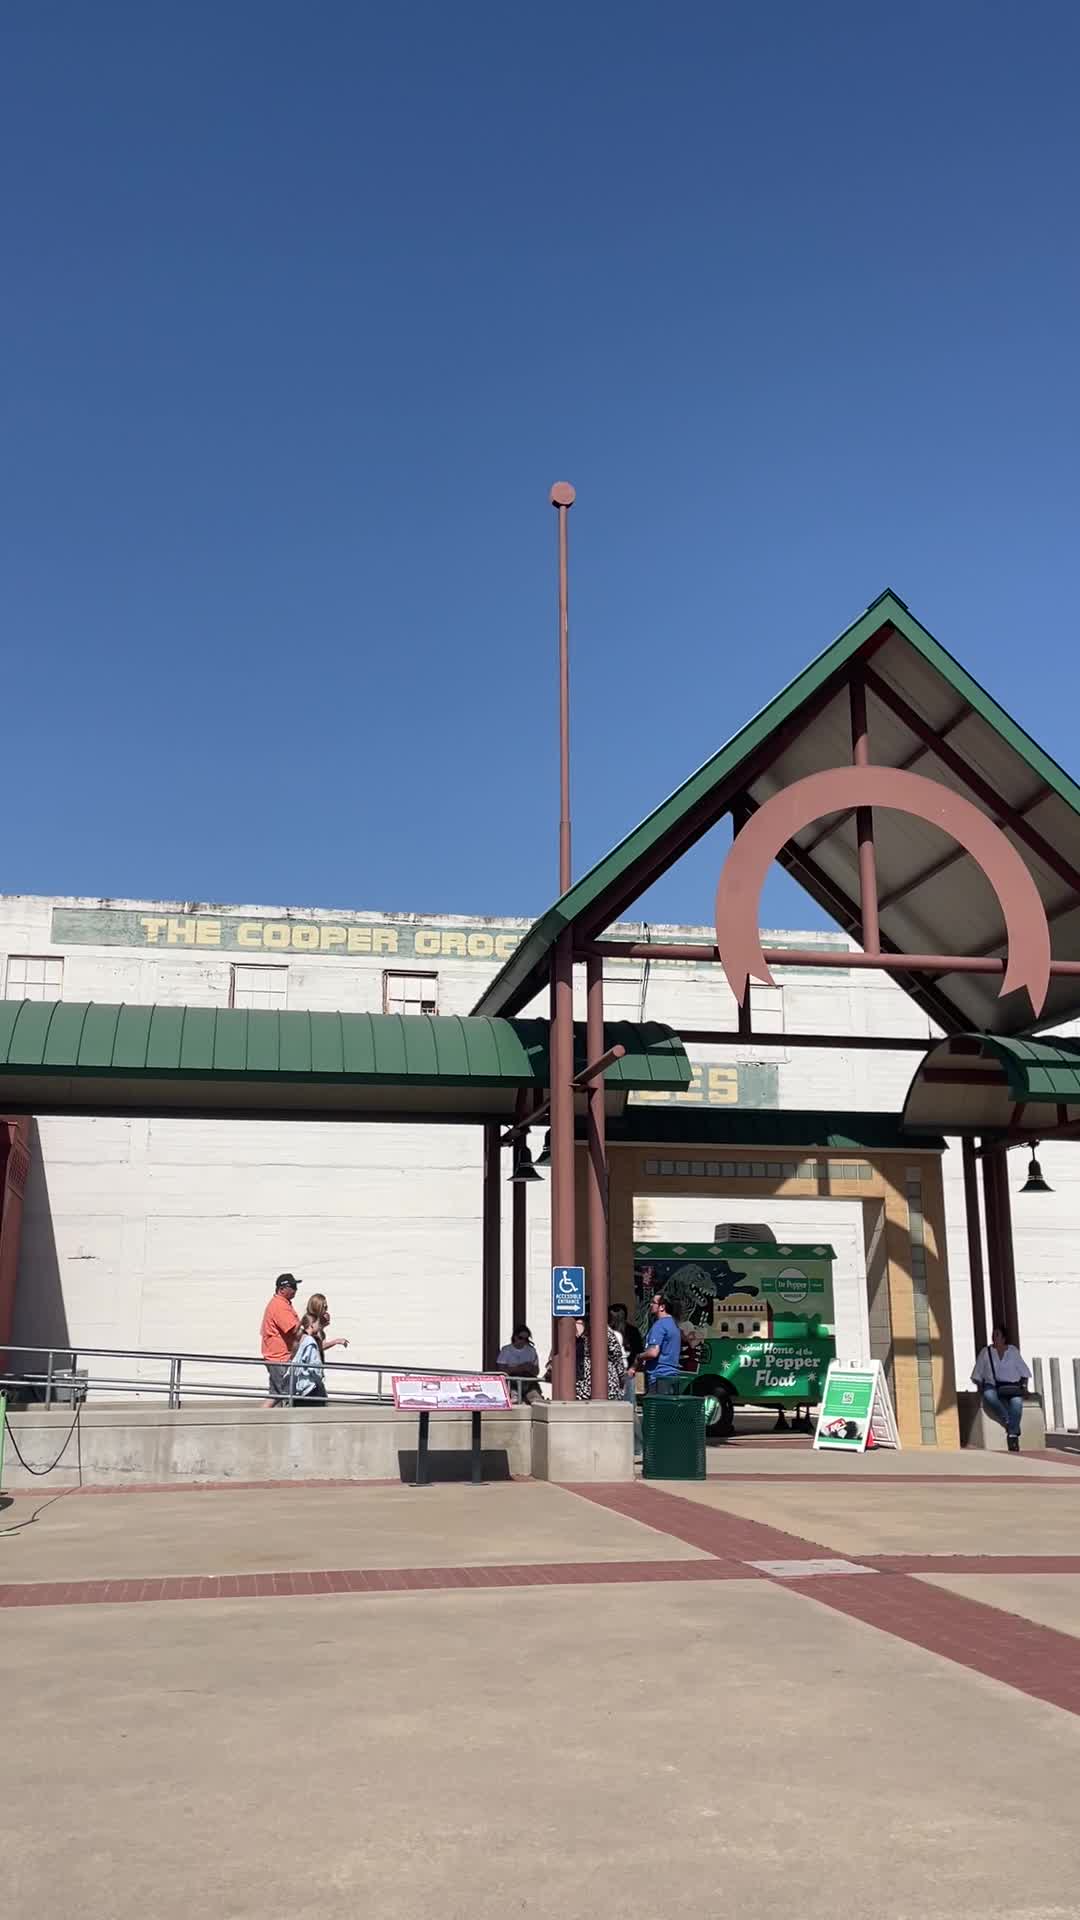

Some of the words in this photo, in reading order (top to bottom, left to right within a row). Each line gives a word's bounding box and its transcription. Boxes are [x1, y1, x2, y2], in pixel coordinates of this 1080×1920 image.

[140, 917, 221, 945] THE
[237, 921, 399, 953] COOPER
[414, 929, 525, 959] GROC
[786, 1280, 807, 1290] Pepper
[736, 1343, 763, 1352] Original
[763, 1342, 794, 1354] Home
[795, 1348, 803, 1356] of
[803, 1347, 813, 1355] the
[738, 1354, 760, 1368] Dr
[765, 1354, 821, 1370] Pepper
[755, 1369, 797, 1387] Float
